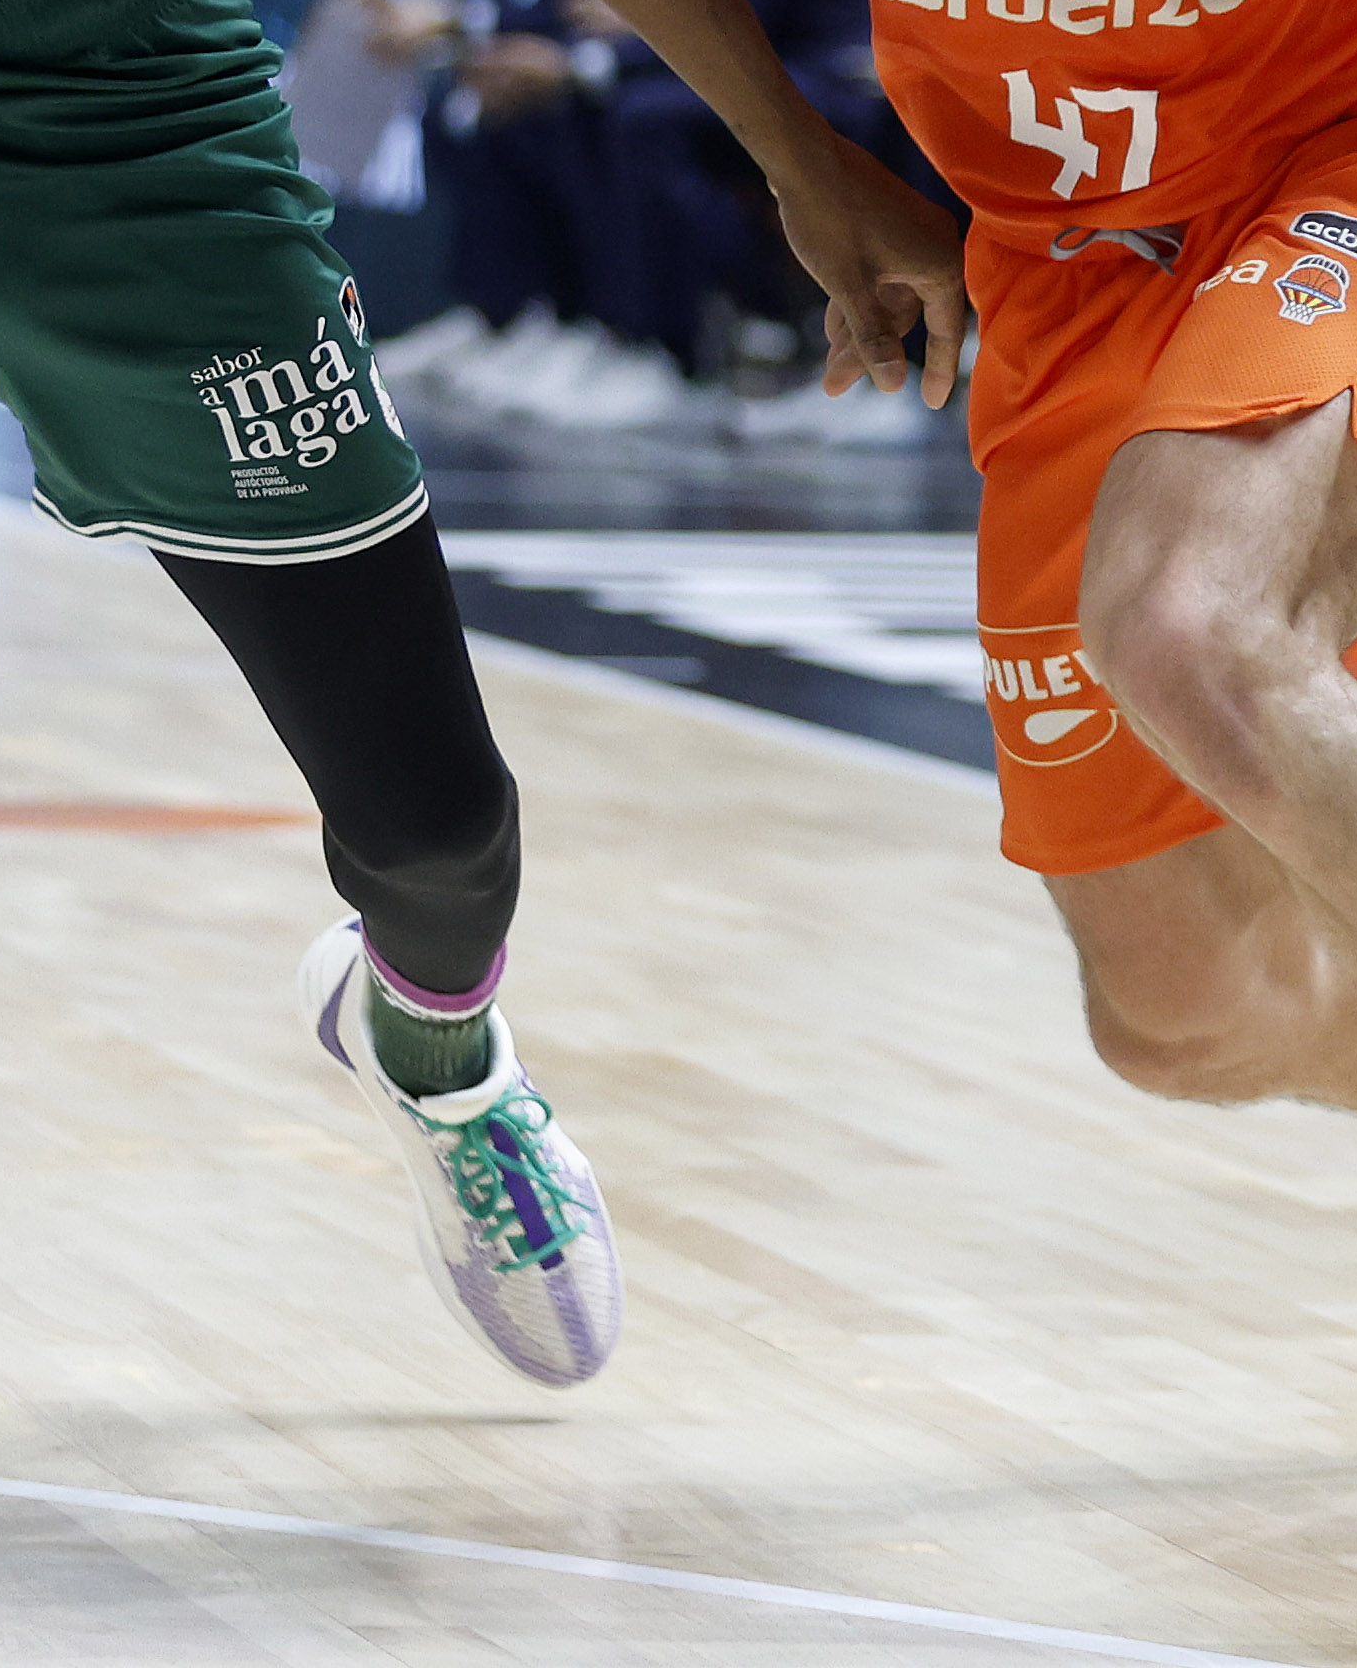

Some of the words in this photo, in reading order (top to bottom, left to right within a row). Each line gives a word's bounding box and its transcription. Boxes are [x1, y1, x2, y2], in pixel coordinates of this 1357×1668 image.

[1001, 68, 1160, 200] 47
[190, 346, 263, 385] sabor
[198, 386, 225, 407] a
[224, 316, 356, 419] má
[210, 387, 371, 469] laga
[231, 465, 280, 479] PRODUCTOS
[236, 487, 249, 500] DE
[249, 487, 262, 500] LA
[262, 482, 310, 499] PROVINCIA
